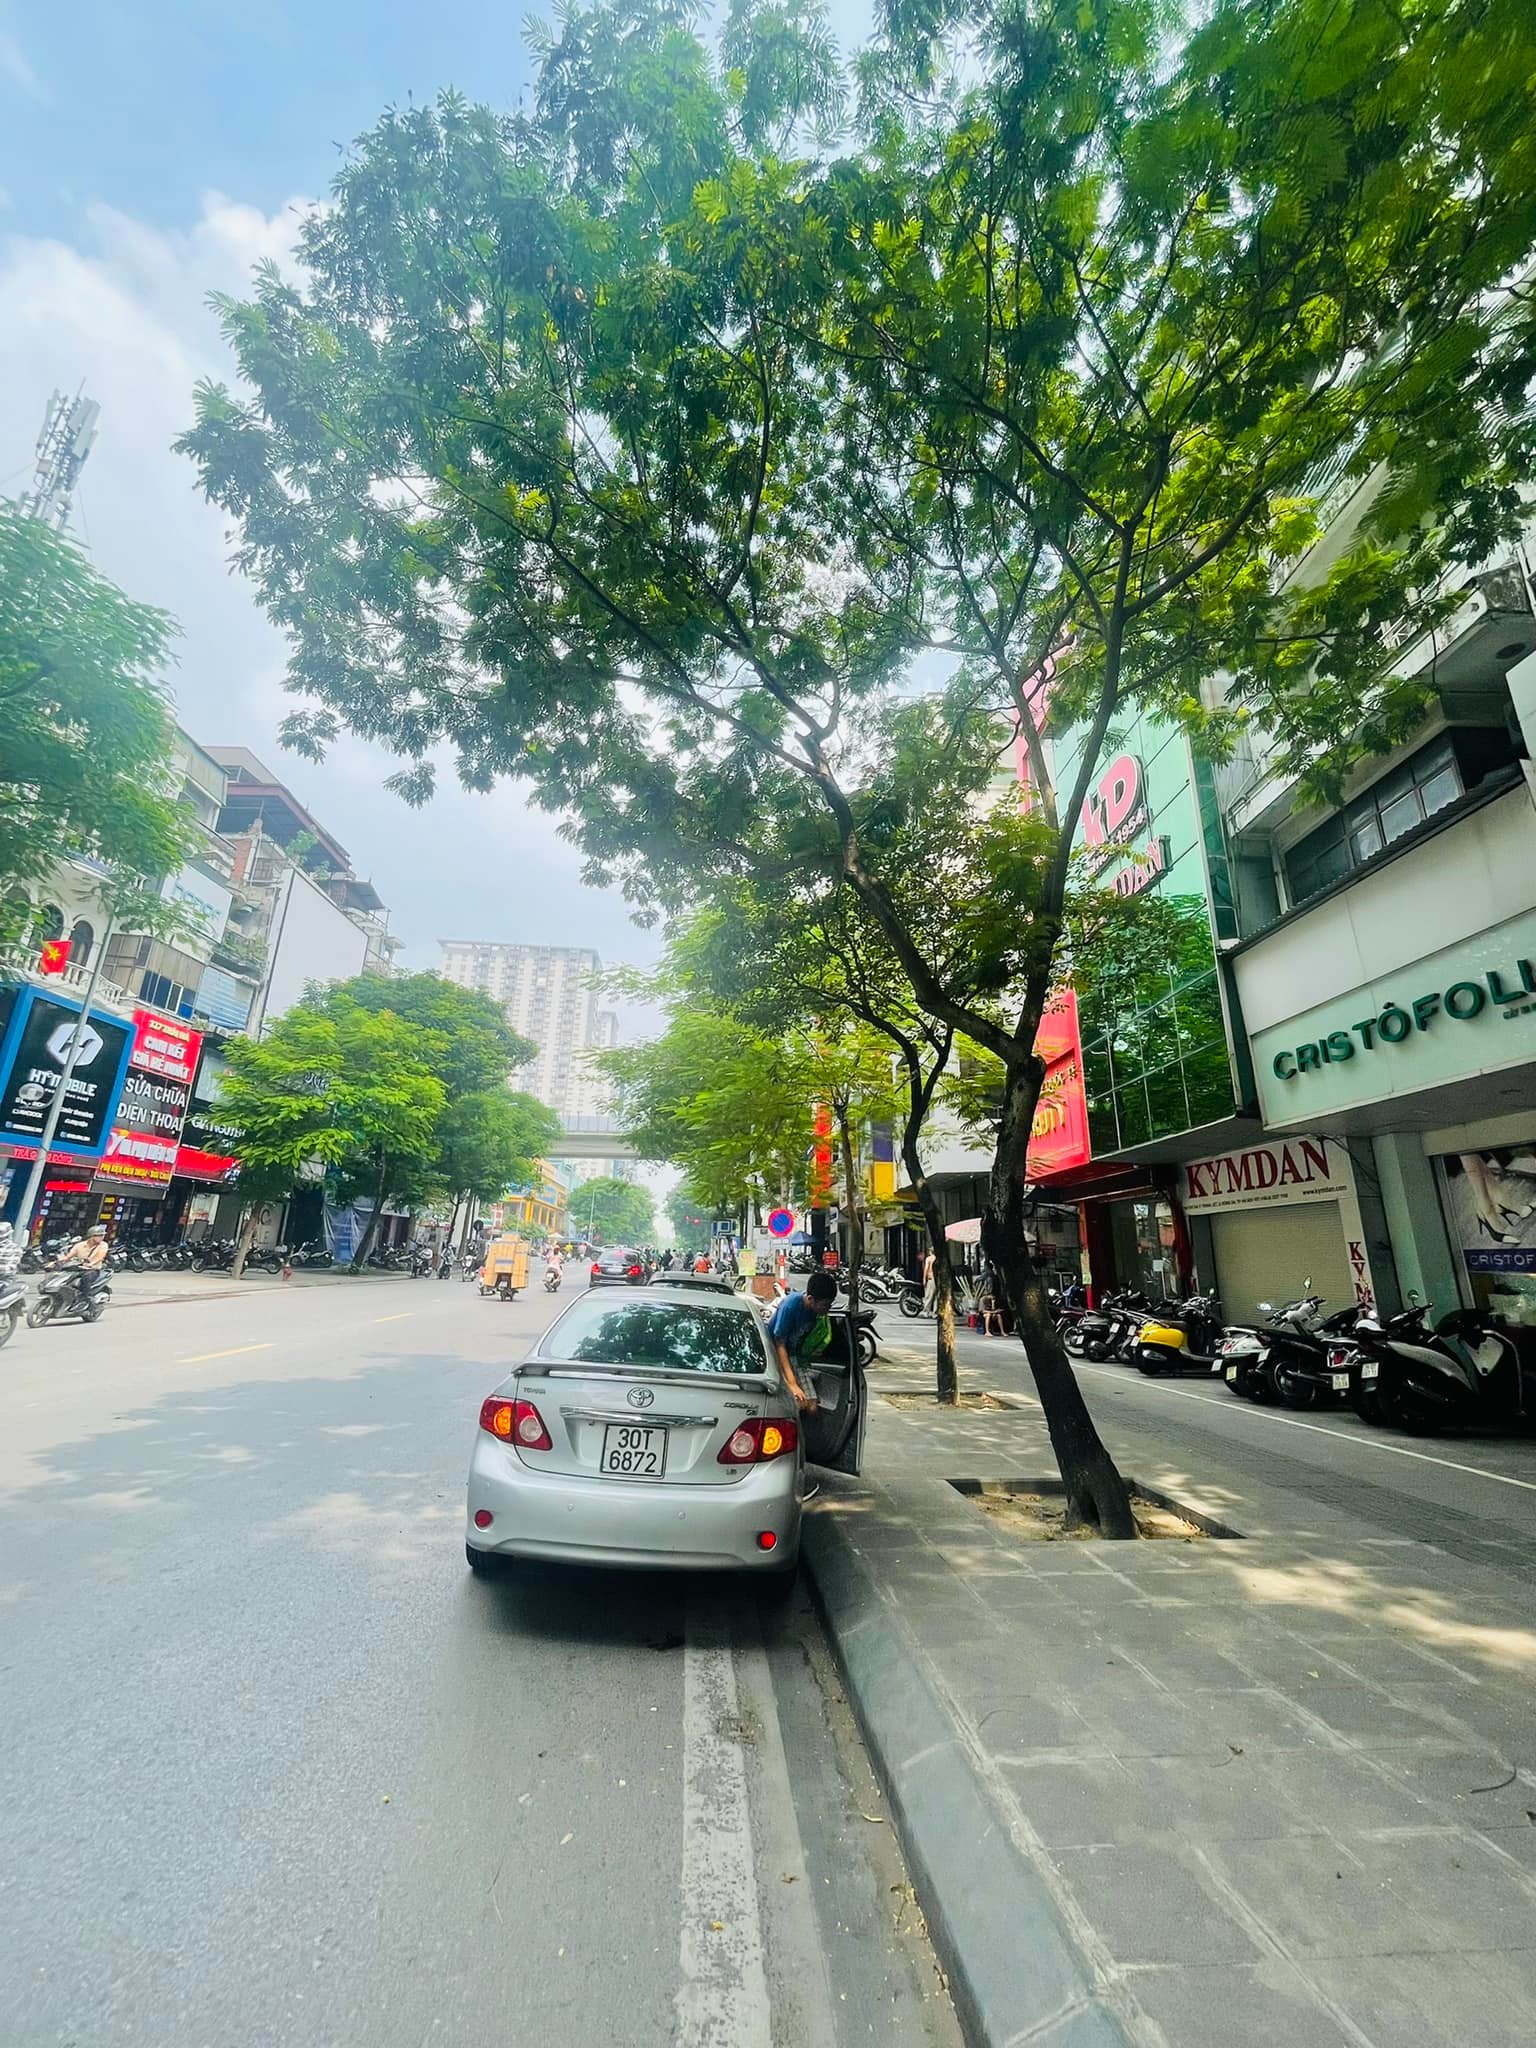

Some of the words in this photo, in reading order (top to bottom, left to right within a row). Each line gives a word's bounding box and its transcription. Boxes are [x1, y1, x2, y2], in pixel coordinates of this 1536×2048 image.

[125, 1074, 152, 1098] SỬA
[154, 1086, 186, 1108] CHỮA
[116, 1101, 148, 1125] ĐIỆN
[149, 1110, 182, 1135] THOẠI
[1185, 1140, 1331, 1199] KYMDAN
[617, 1428, 654, 1450] 30T
[609, 1450, 657, 1474] 6872
